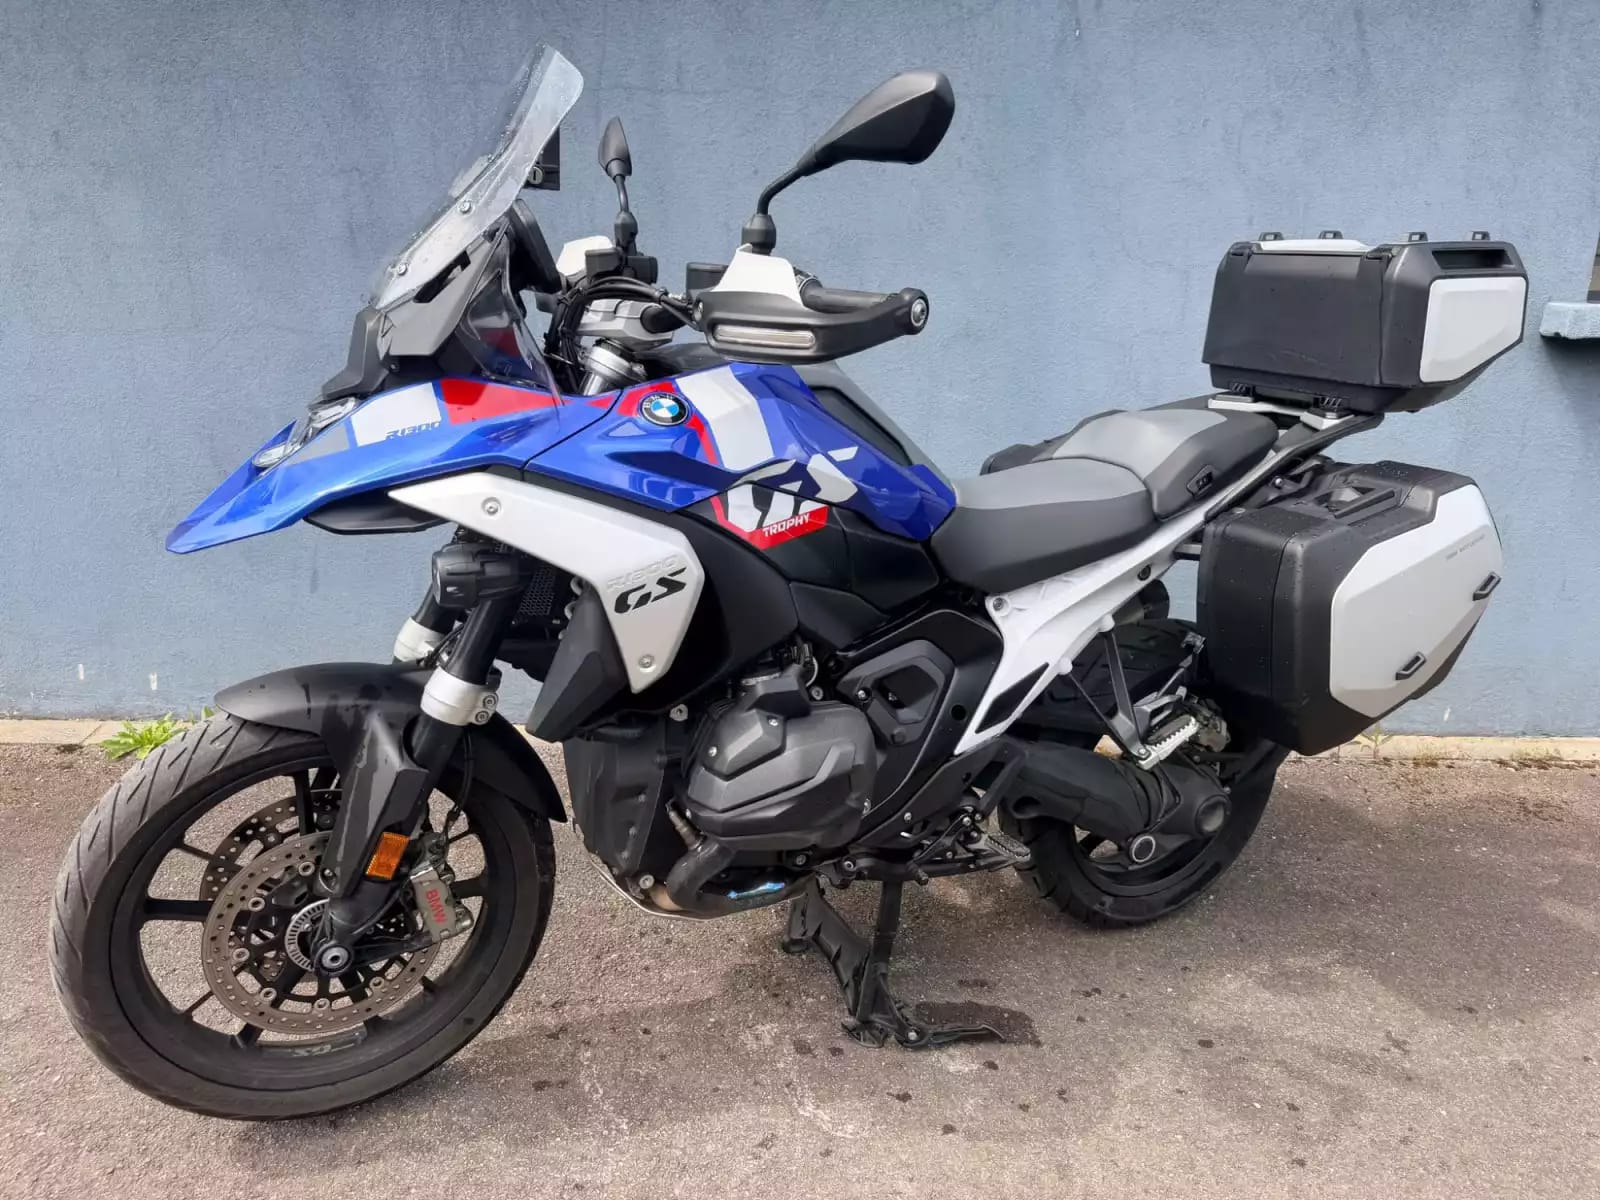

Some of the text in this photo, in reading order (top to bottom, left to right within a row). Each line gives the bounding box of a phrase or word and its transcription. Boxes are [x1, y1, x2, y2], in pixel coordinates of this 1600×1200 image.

[762, 512, 810, 537] TROPHY
[614, 566, 687, 614] GS
[425, 888, 448, 924] BMW
